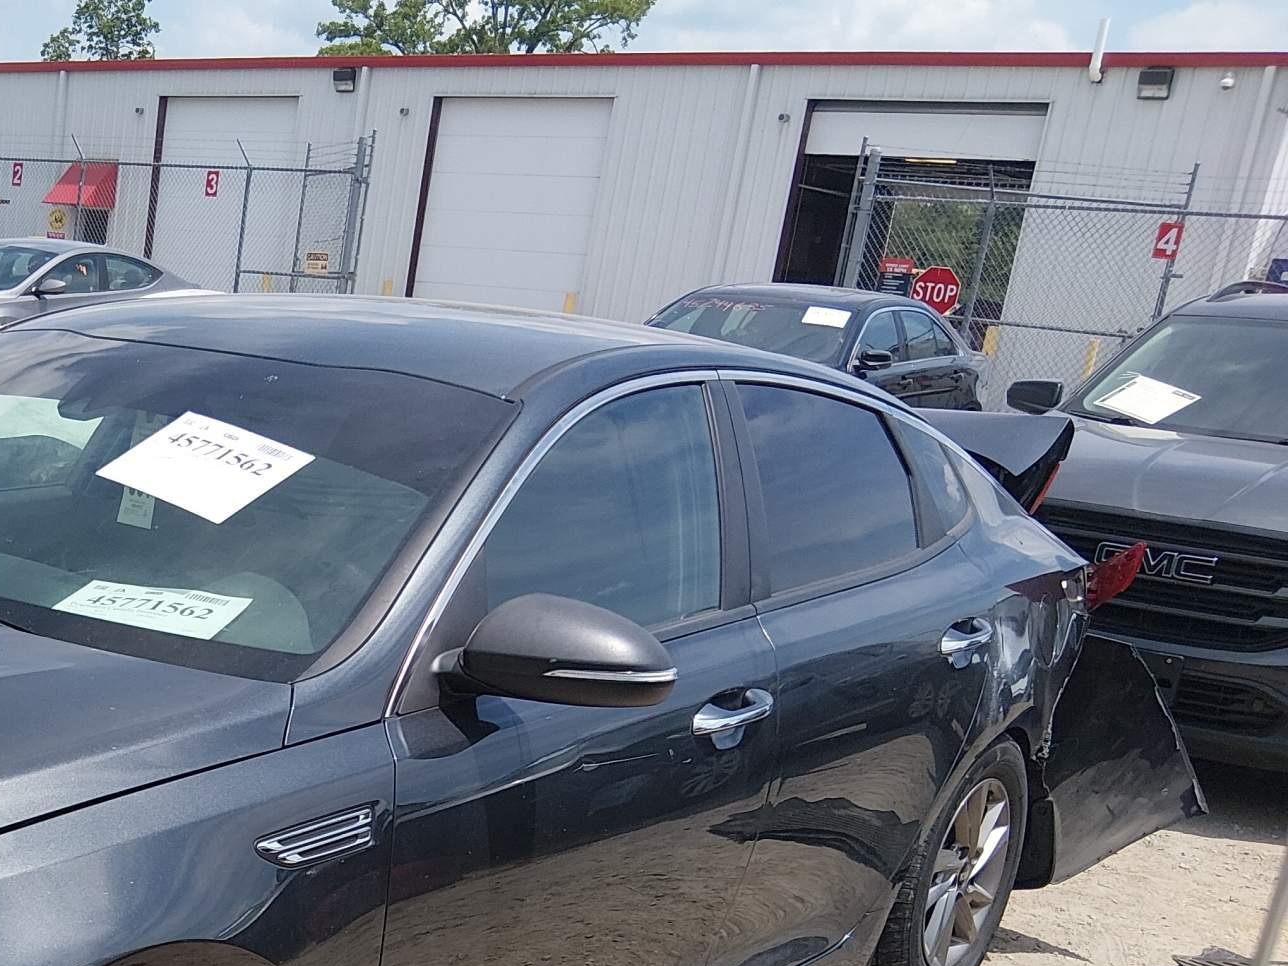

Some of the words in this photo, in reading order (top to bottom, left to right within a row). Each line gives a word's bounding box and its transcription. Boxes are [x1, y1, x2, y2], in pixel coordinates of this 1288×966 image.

[13, 165, 22, 184] 2
[206, 173, 218, 194] 3
[1156, 227, 1179, 256] 4
[913, 281, 957, 303] STOP
[168, 432, 273, 476] 45771562
[87, 594, 214, 620] 45771562
